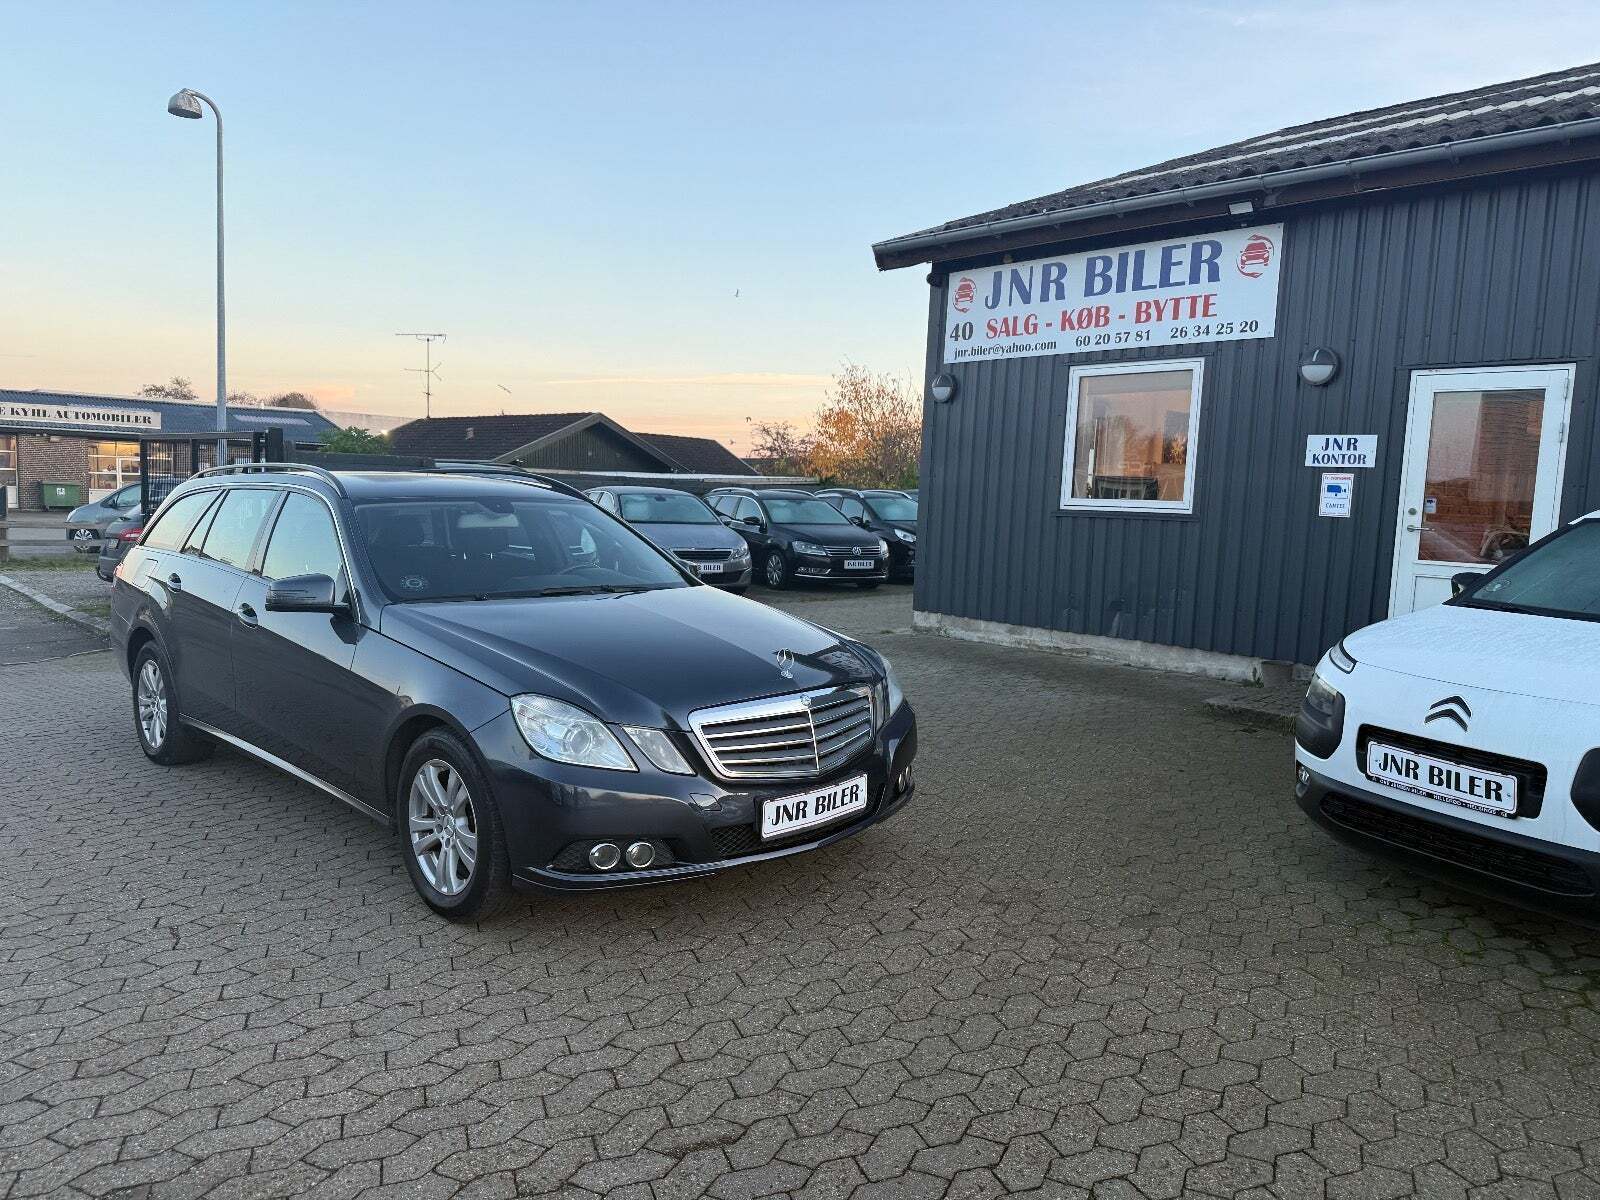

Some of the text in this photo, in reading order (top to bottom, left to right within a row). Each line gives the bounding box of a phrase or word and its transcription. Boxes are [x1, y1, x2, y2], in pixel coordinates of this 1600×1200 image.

[984, 239, 1223, 310] JNR BILER
[985, 313, 1039, 340] SALG
[1060, 305, 1111, 332] KØB
[1134, 293, 1218, 325] BYTTE
[949, 321, 974, 342] 40
[1075, 329, 1151, 347] 60 20 57 81
[1170, 319, 1259, 339] 26 34 25 20
[953, 340, 1058, 361] jnr.biler@yahoo.com
[54, 410, 152, 425] AUTOMOBILER
[1321, 437, 1359, 452] JNR
[1311, 453, 1367, 465] KONTOR
[1378, 752, 1419, 781] JNR
[1428, 764, 1503, 803] BILER
[771, 783, 860, 826] JNR BILER
